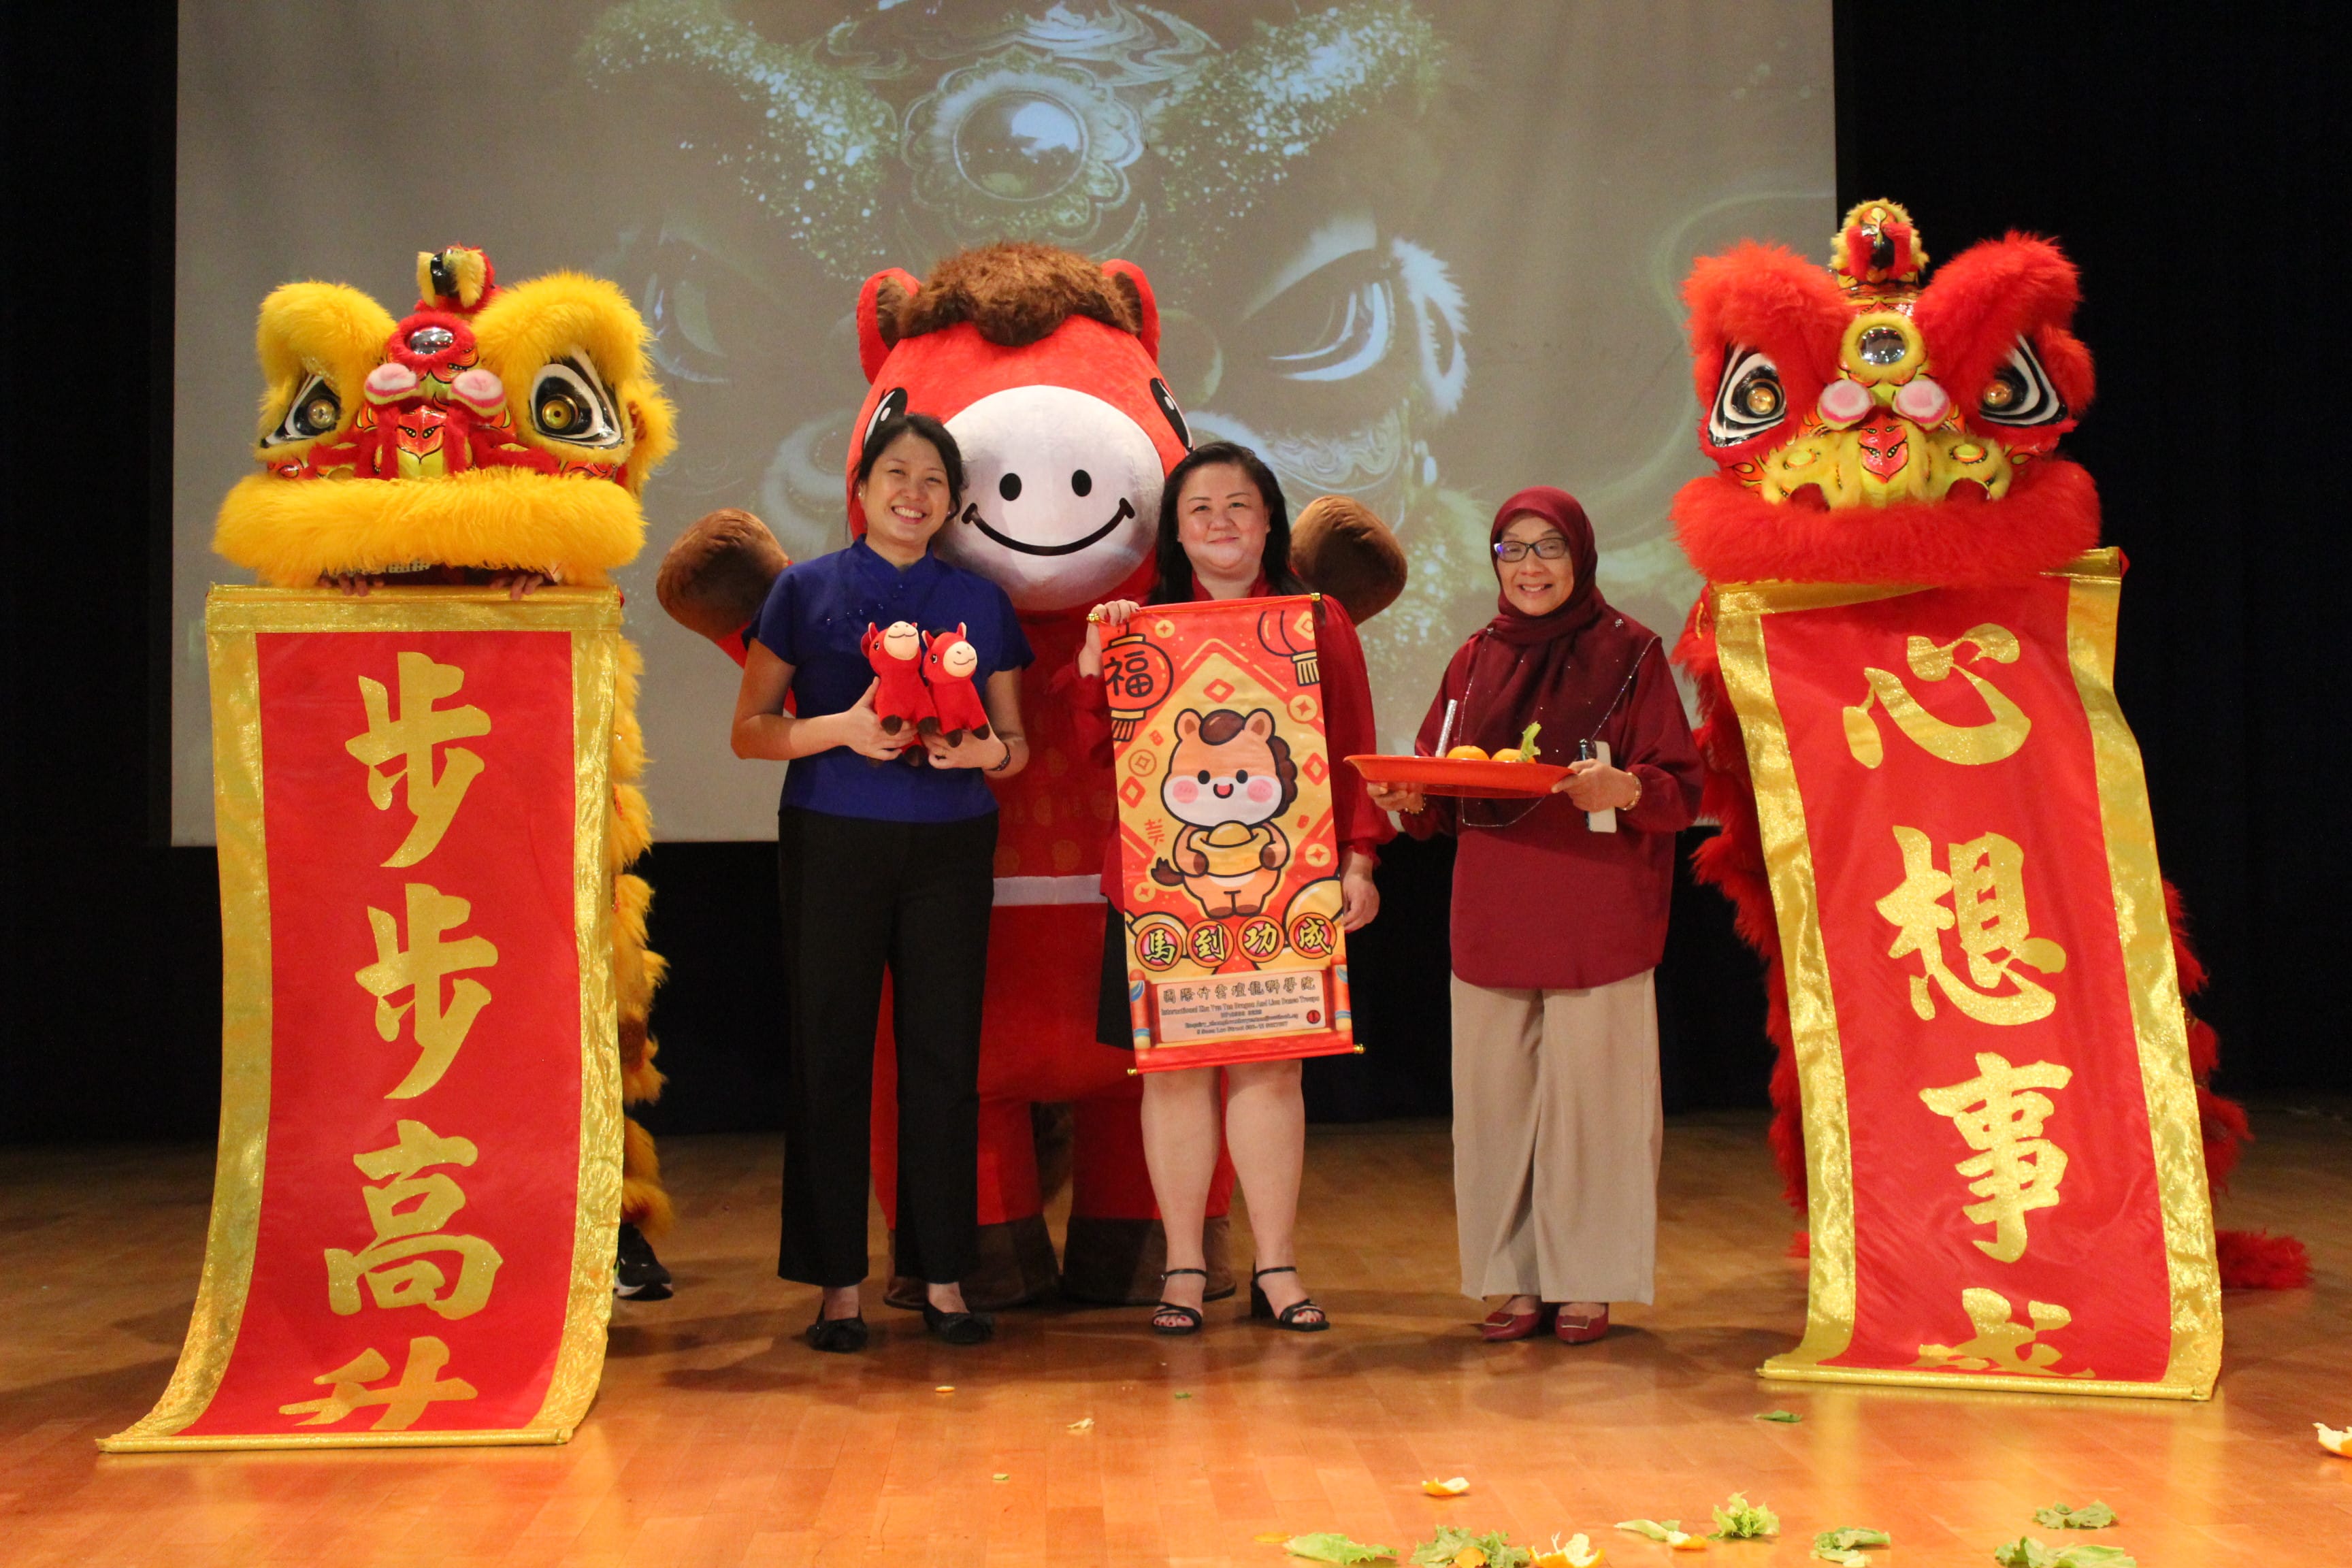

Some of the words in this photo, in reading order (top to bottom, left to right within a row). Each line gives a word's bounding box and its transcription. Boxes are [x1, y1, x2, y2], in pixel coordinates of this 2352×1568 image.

[1104, 650, 1154, 698] 福
[1144, 917, 1333, 965] 馬到功成
[278, 651, 504, 1431] 步步高升
